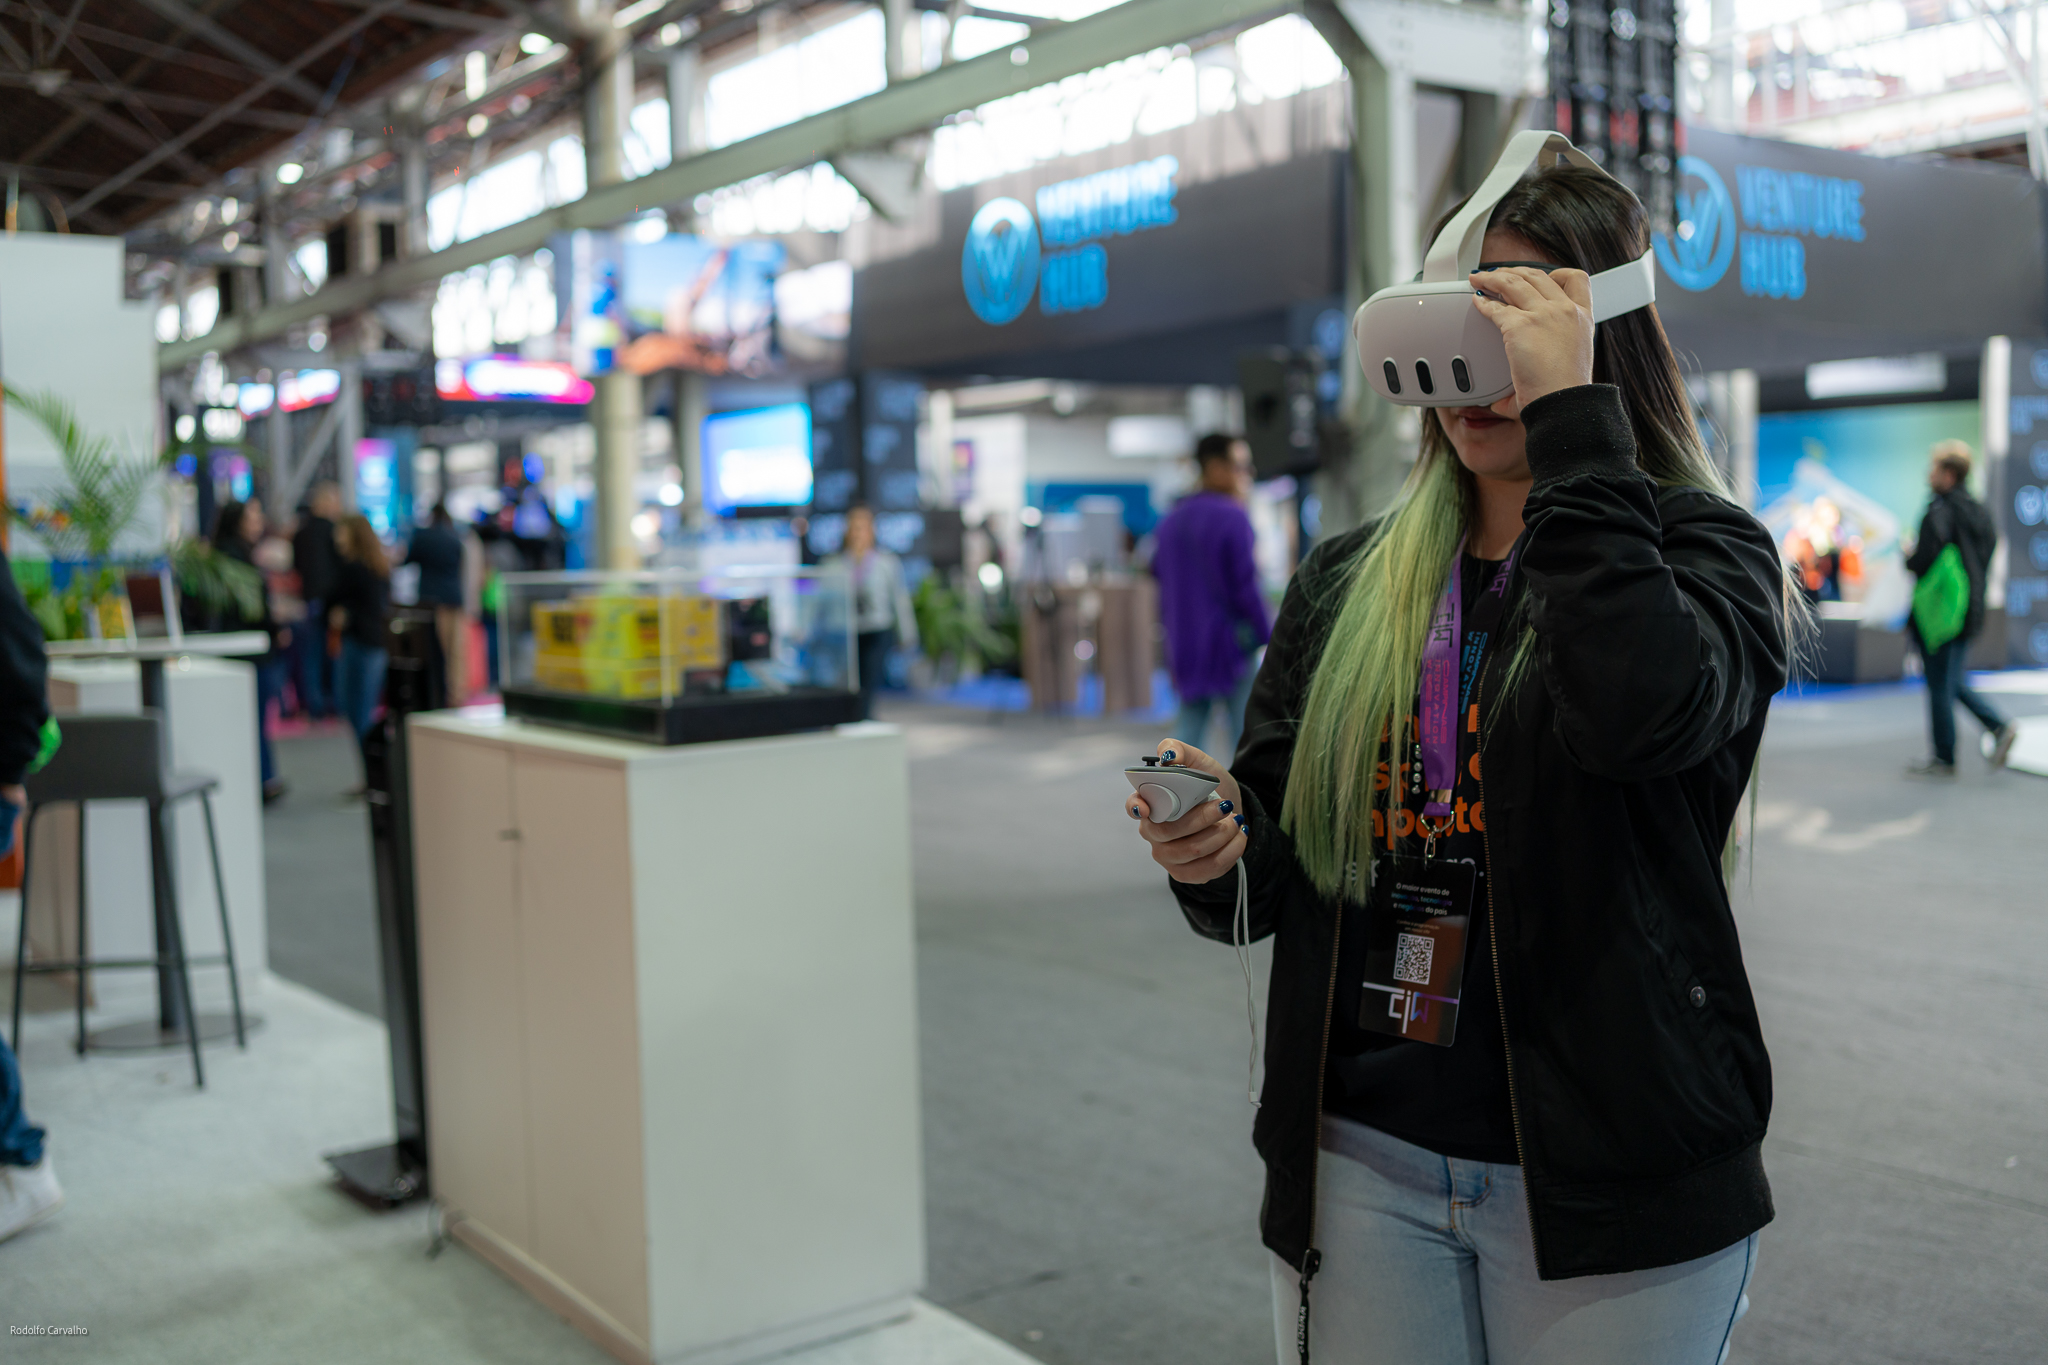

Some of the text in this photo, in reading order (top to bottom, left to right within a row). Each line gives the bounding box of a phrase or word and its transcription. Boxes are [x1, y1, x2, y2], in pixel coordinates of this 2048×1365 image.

[1037, 155, 1178, 247] VENTURE
[1735, 164, 1866, 242] VENTURE
[1040, 243, 1108, 316] HUB
[1740, 231, 1807, 300] HUB
[1432, 659, 1441, 745] INNOVATION
[1420, 886, 1441, 895] evento
[1425, 906, 1433, 914] do
